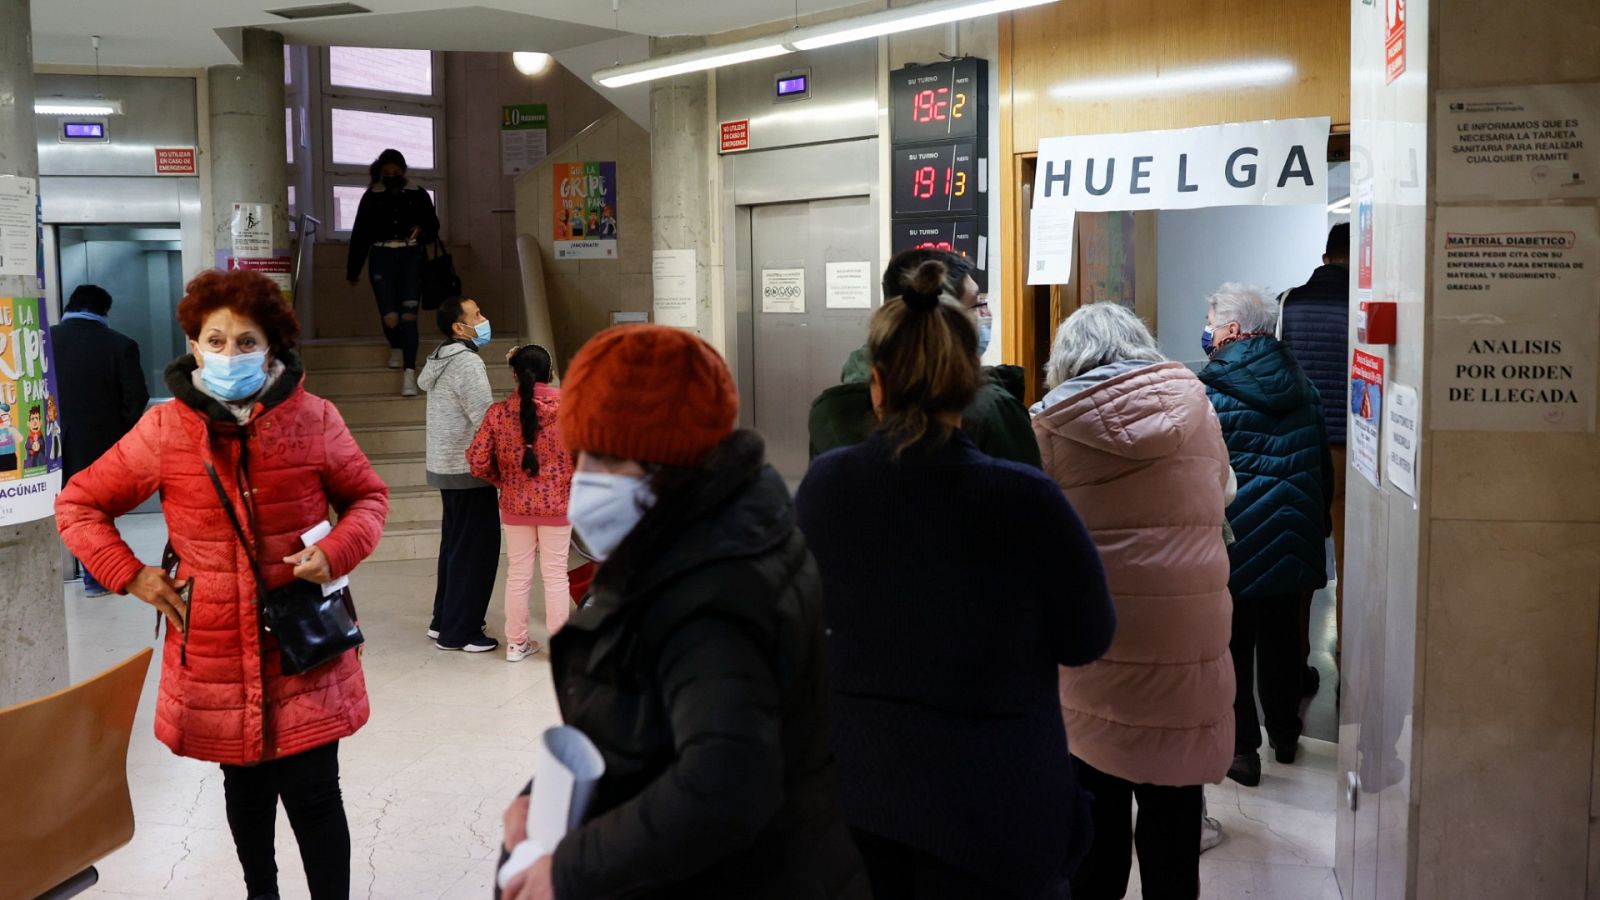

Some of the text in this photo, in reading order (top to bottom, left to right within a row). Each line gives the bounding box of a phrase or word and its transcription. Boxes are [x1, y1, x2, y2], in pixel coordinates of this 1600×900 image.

[917, 76, 938, 84] TURNO
[952, 94, 966, 118] 2
[1457, 119, 1578, 132] LE INFORMAMOS QUE ES
[1459, 130, 1576, 142] NECESARIA LA TARJETA
[1452, 141, 1583, 153] SANITARIA PARA REALIZAR
[1466, 152, 1569, 164] CUALQUIER TRAMITE
[1044, 145, 1314, 197] HUELGA
[560, 174, 607, 198] GRIPE
[914, 166, 966, 198] 191 3
[1448, 236, 1566, 245] MATERIAL DIABETICO
[18, 304, 33, 325] LA
[1468, 340, 1562, 354] ANALISIS
[1456, 365, 1573, 379] POR ORDEN
[1449, 388, 1578, 404] DE LLEGADA
[0, 482, 47, 498] ACÚNATE!
